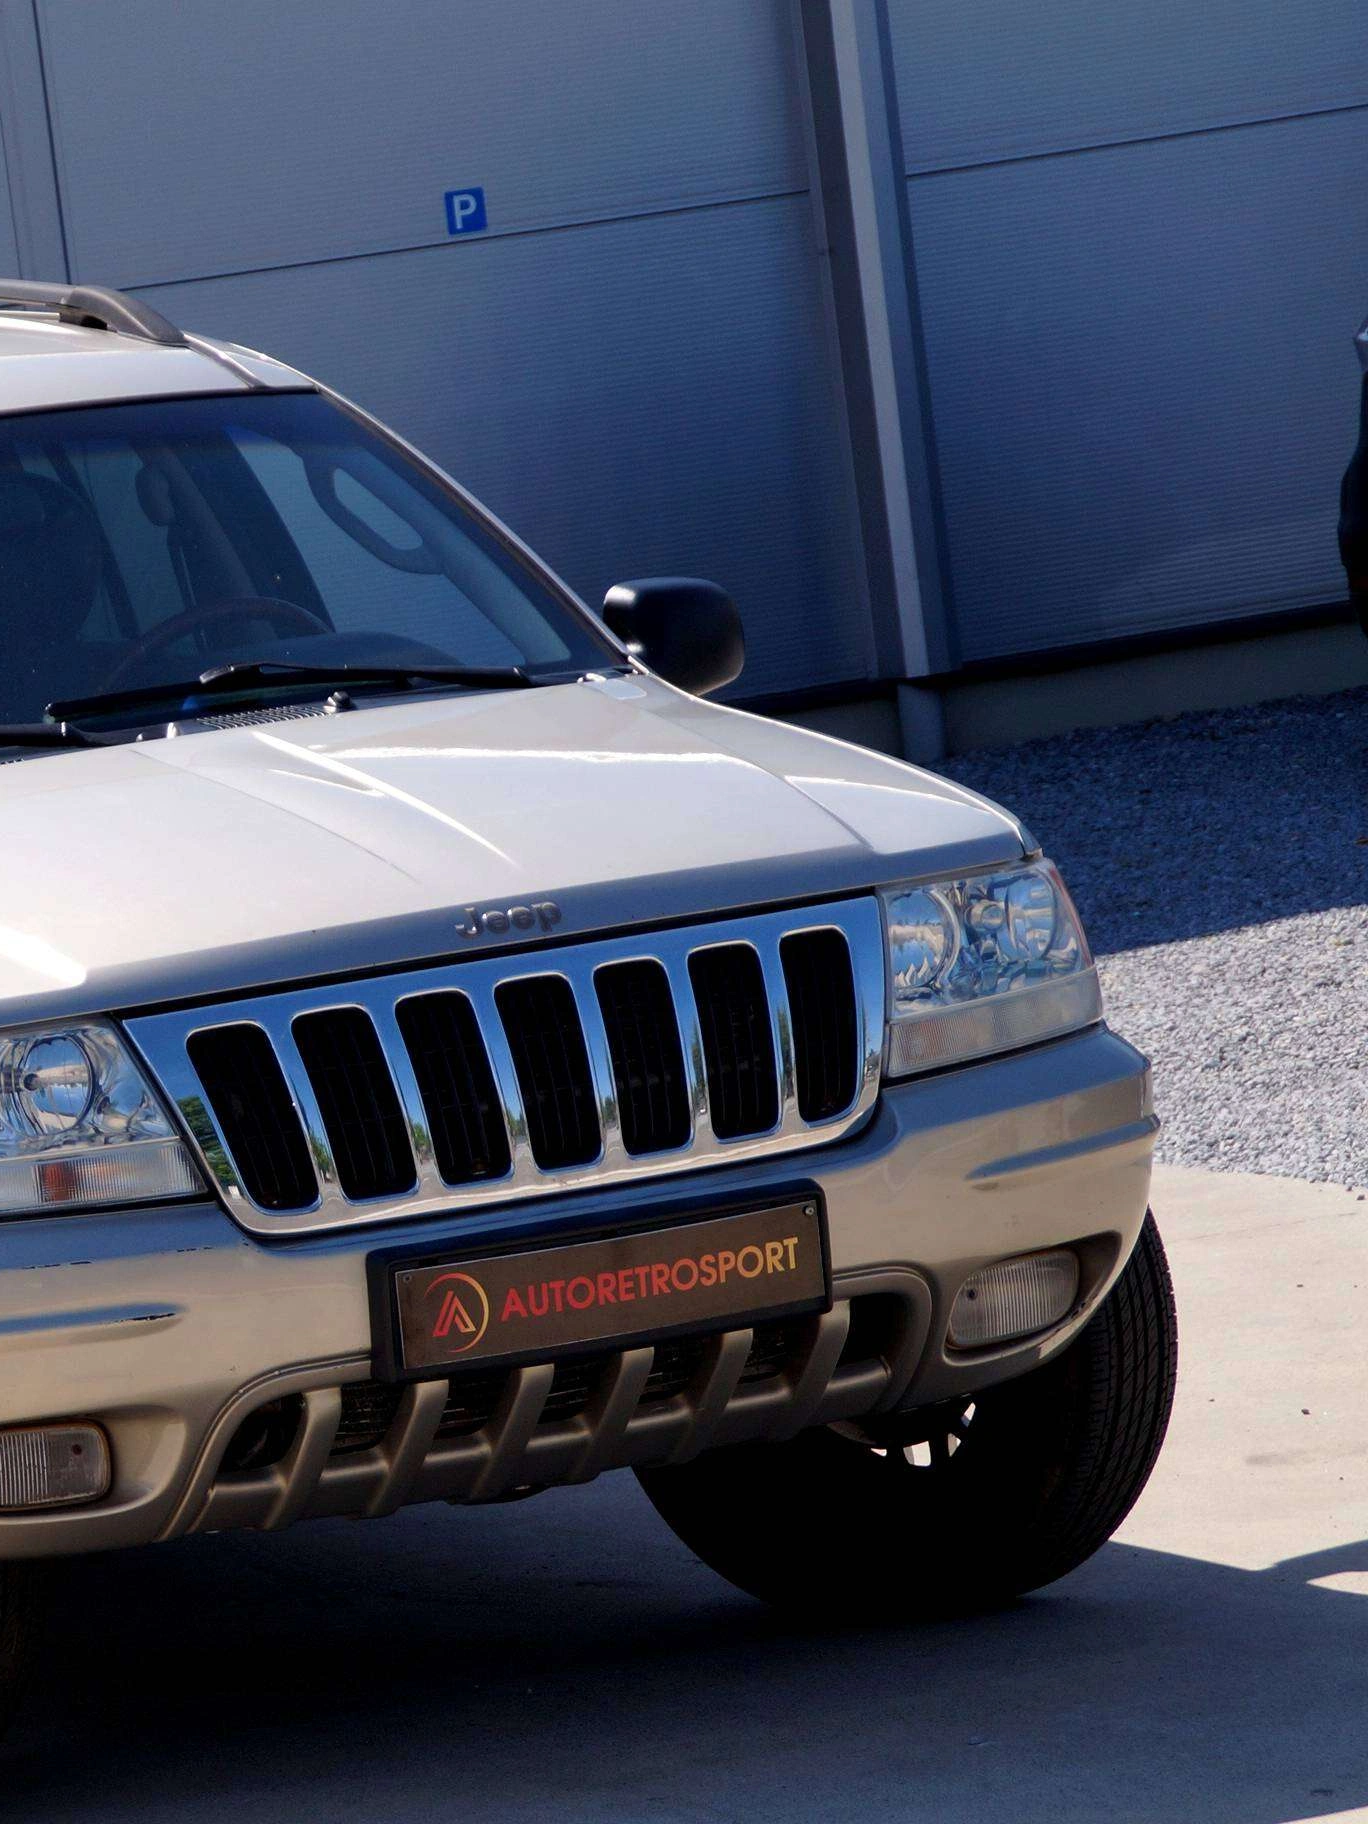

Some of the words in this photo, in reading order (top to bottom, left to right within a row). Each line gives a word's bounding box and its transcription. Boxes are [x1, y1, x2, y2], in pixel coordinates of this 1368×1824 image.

[453, 193, 477, 230] P
[454, 901, 562, 938] Jeep
[500, 1236, 799, 1322] AUTORETROSPORT
